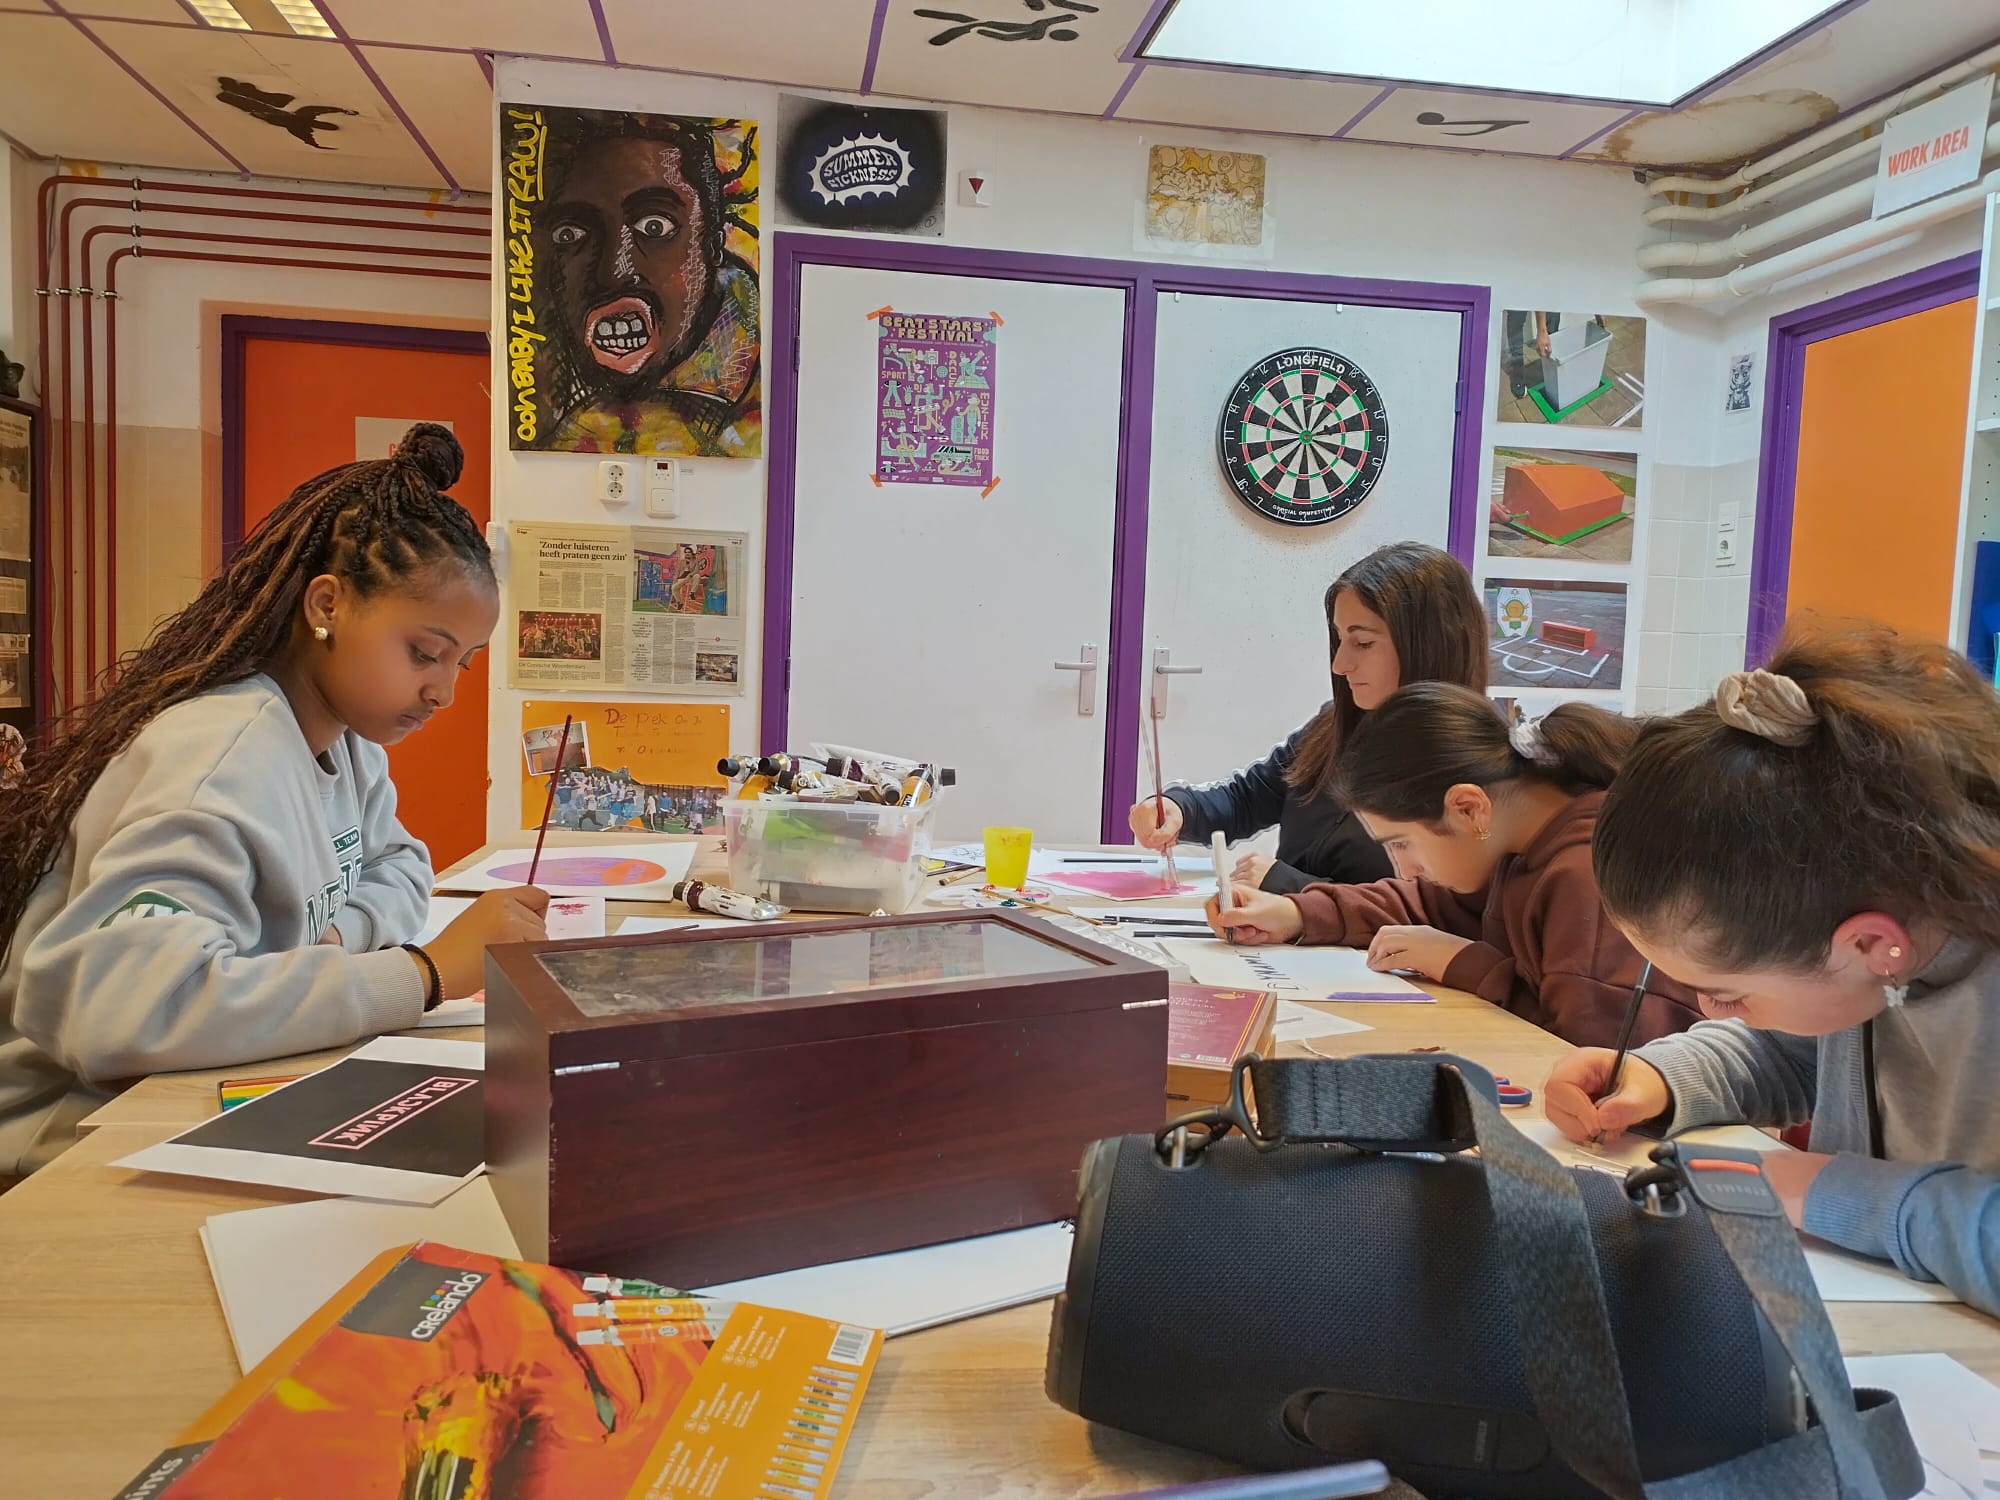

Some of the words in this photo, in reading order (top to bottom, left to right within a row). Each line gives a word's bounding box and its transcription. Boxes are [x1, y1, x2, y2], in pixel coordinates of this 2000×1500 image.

[1888, 141, 1930, 177] WORK
[1931, 125, 1969, 161] AREA
[824, 148, 898, 177] SUMMER
[827, 166, 898, 188] SICKNESS
[509, 197, 532, 234] IT
[898, 328, 974, 342] FESTIVAL
[928, 318, 983, 332] STARS
[509, 325, 546, 389] BABY
[1276, 354, 1346, 374] LONGFIELD
[539, 550, 561, 558] heeft
[562, 552, 590, 560] praten
[591, 553, 611, 561] geen
[573, 542, 610, 552] luisteren
[343, 831, 358, 845] TEAM
[124, 1458, 183, 1500] ints
